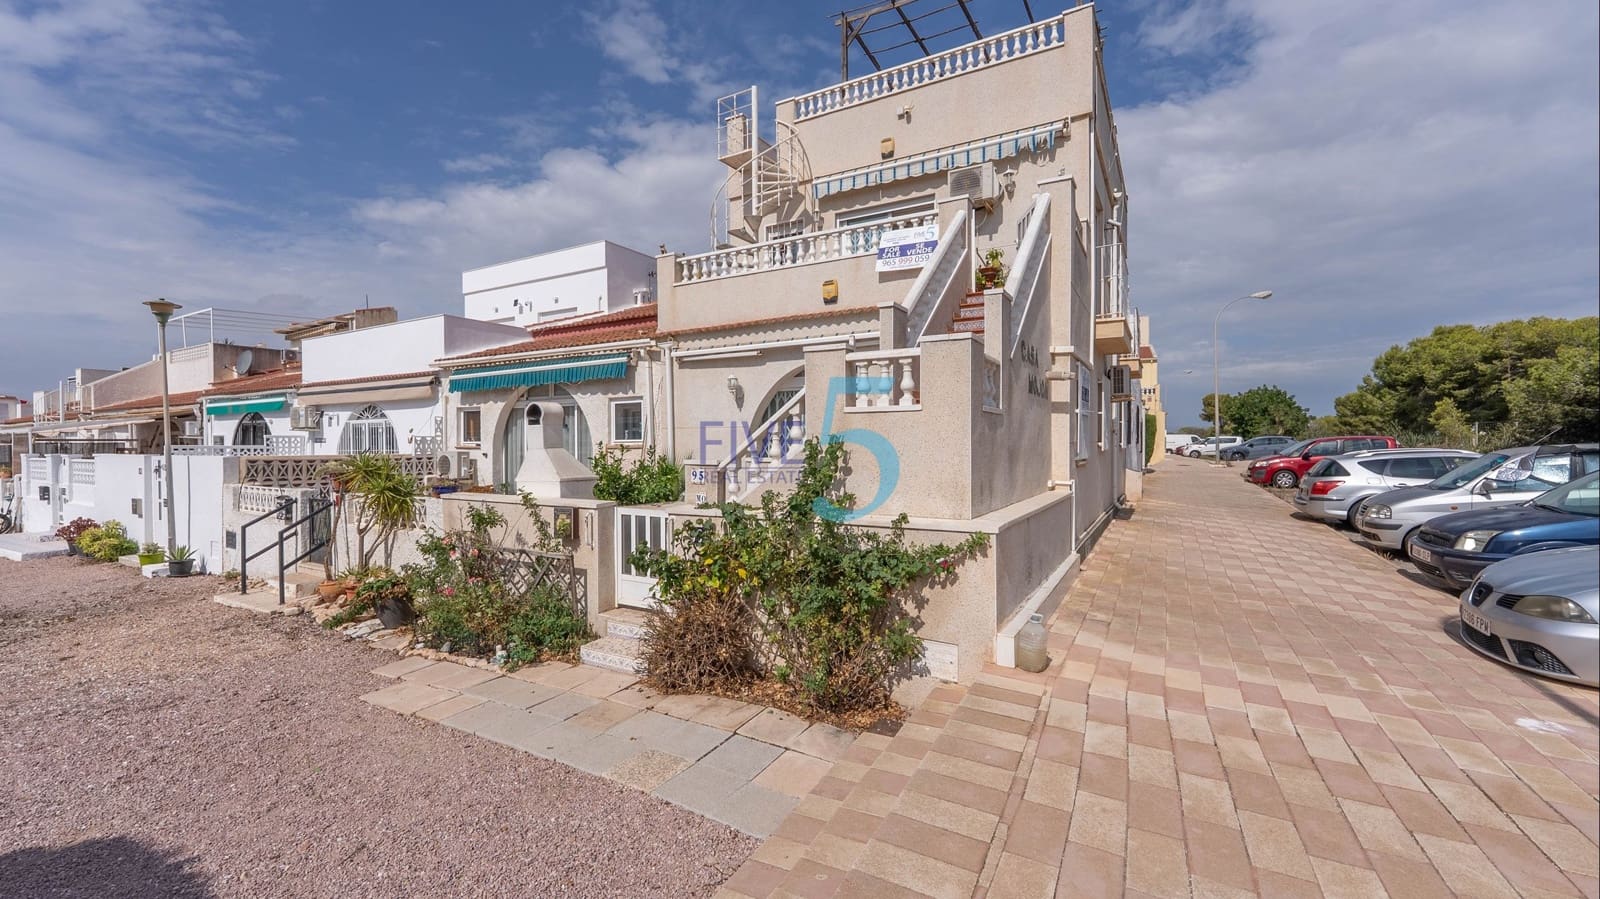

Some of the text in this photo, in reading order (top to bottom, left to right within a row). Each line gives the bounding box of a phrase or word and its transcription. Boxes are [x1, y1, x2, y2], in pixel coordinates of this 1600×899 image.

[882, 251, 900, 259] SALE
[906, 247, 933, 255] VENDE
[915, 255, 930, 263] 059
[692, 470, 704, 481] 95
